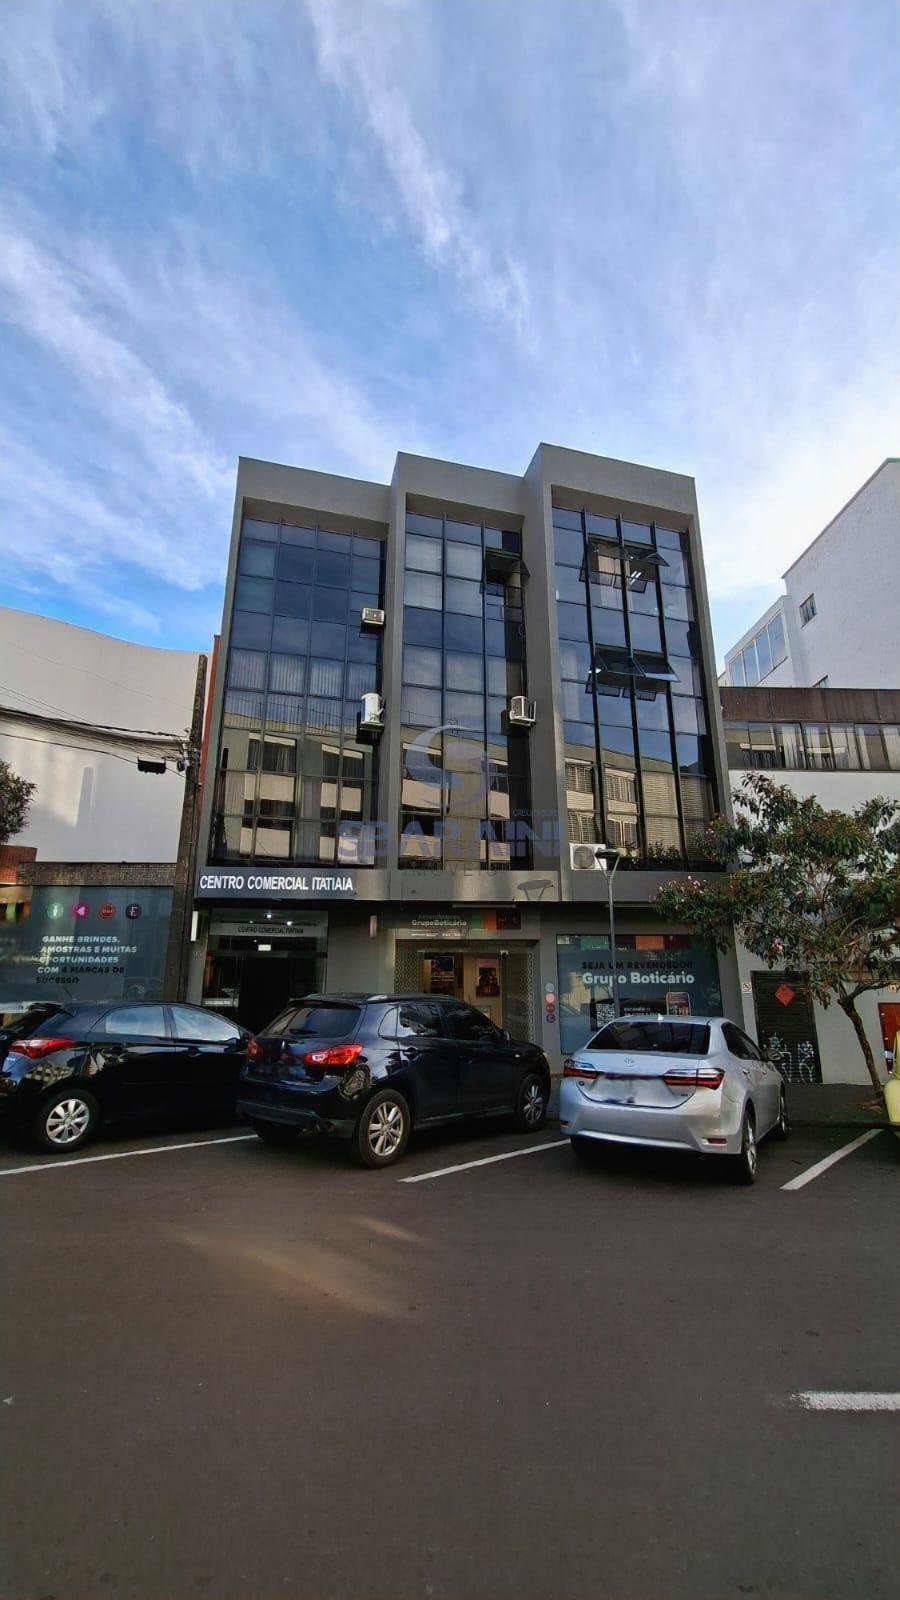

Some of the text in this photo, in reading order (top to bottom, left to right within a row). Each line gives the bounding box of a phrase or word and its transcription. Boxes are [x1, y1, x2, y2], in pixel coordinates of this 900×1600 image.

[200, 875, 354, 891] CENTRO COMERCIAL ITATIAIA
[42, 935, 121, 944] GANHE BRINDES,
[40, 945, 92, 953] AMOSTRAS
[582, 961, 605, 969] SEJA
[627, 961, 693, 969] REVENDEDOR
[70, 966, 110, 974] MARCAS
[36, 976, 80, 984] SUCESSO
[630, 971, 695, 984] Boticário
